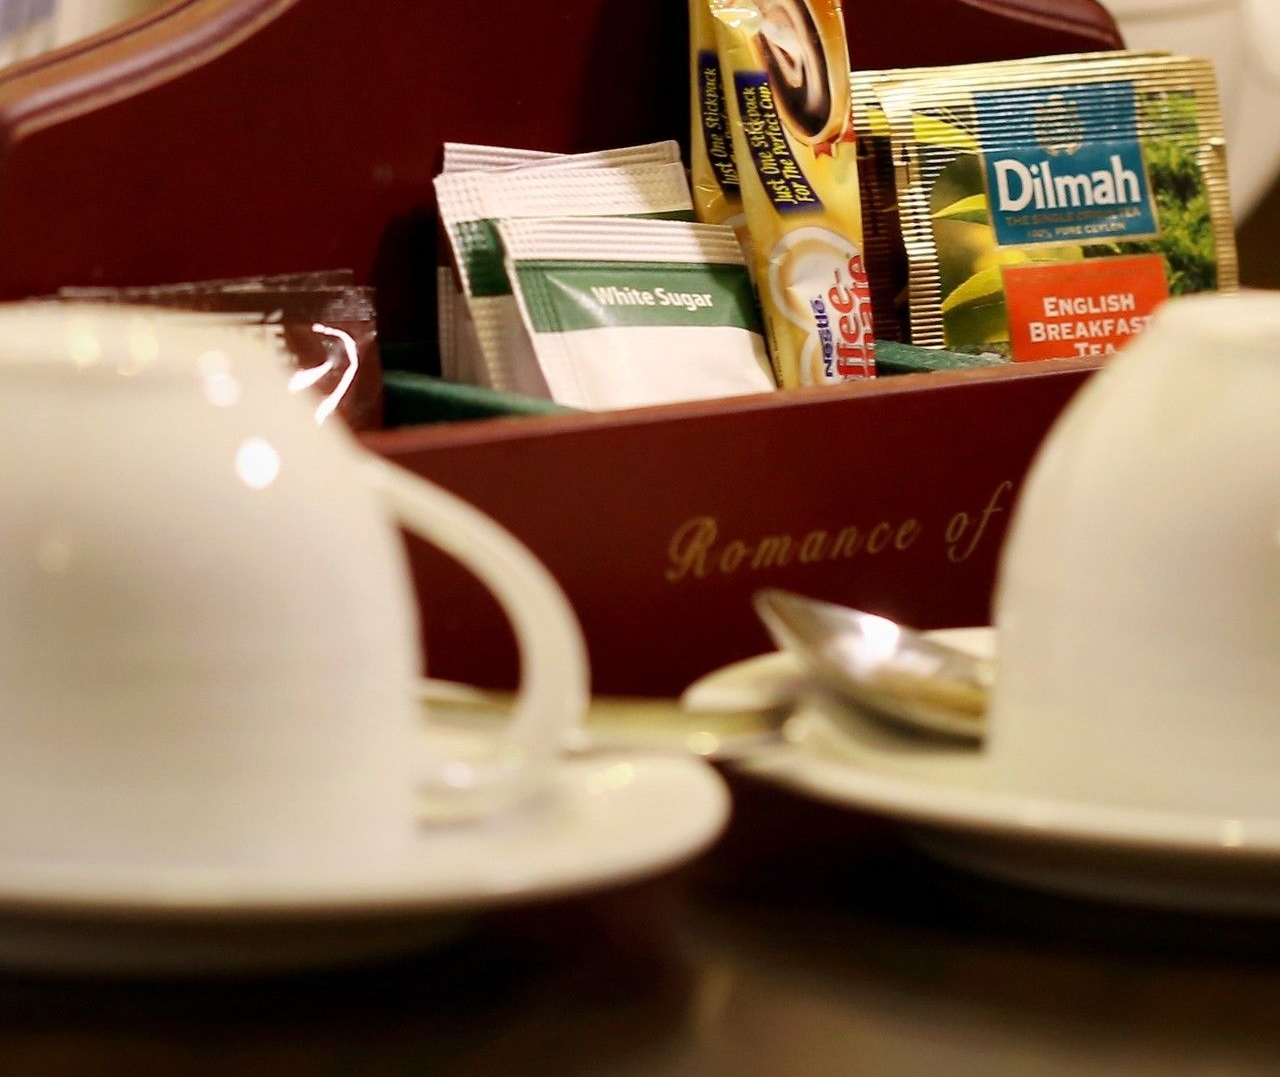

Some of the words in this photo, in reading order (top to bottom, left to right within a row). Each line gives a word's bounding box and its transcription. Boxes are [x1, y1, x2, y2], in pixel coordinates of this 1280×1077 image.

[704, 68, 720, 128] Stickpack
[743, 86, 768, 147] Stickpack
[710, 134, 728, 158] One
[764, 112, 789, 155] Perfect
[759, 151, 780, 174] One
[780, 158, 802, 179] The
[766, 179, 798, 204] Just
[791, 181, 815, 204] For
[993, 154, 1141, 212] Dilmah
[591, 286, 654, 307] White
[655, 288, 714, 312] Sugar
[1042, 293, 1136, 318] ENGLISH
[1028, 314, 1153, 343] BREAKFAST
[1074, 341, 1115, 358] TEA
[665, 516, 920, 582] Romance
[945, 480, 1012, 563] of
